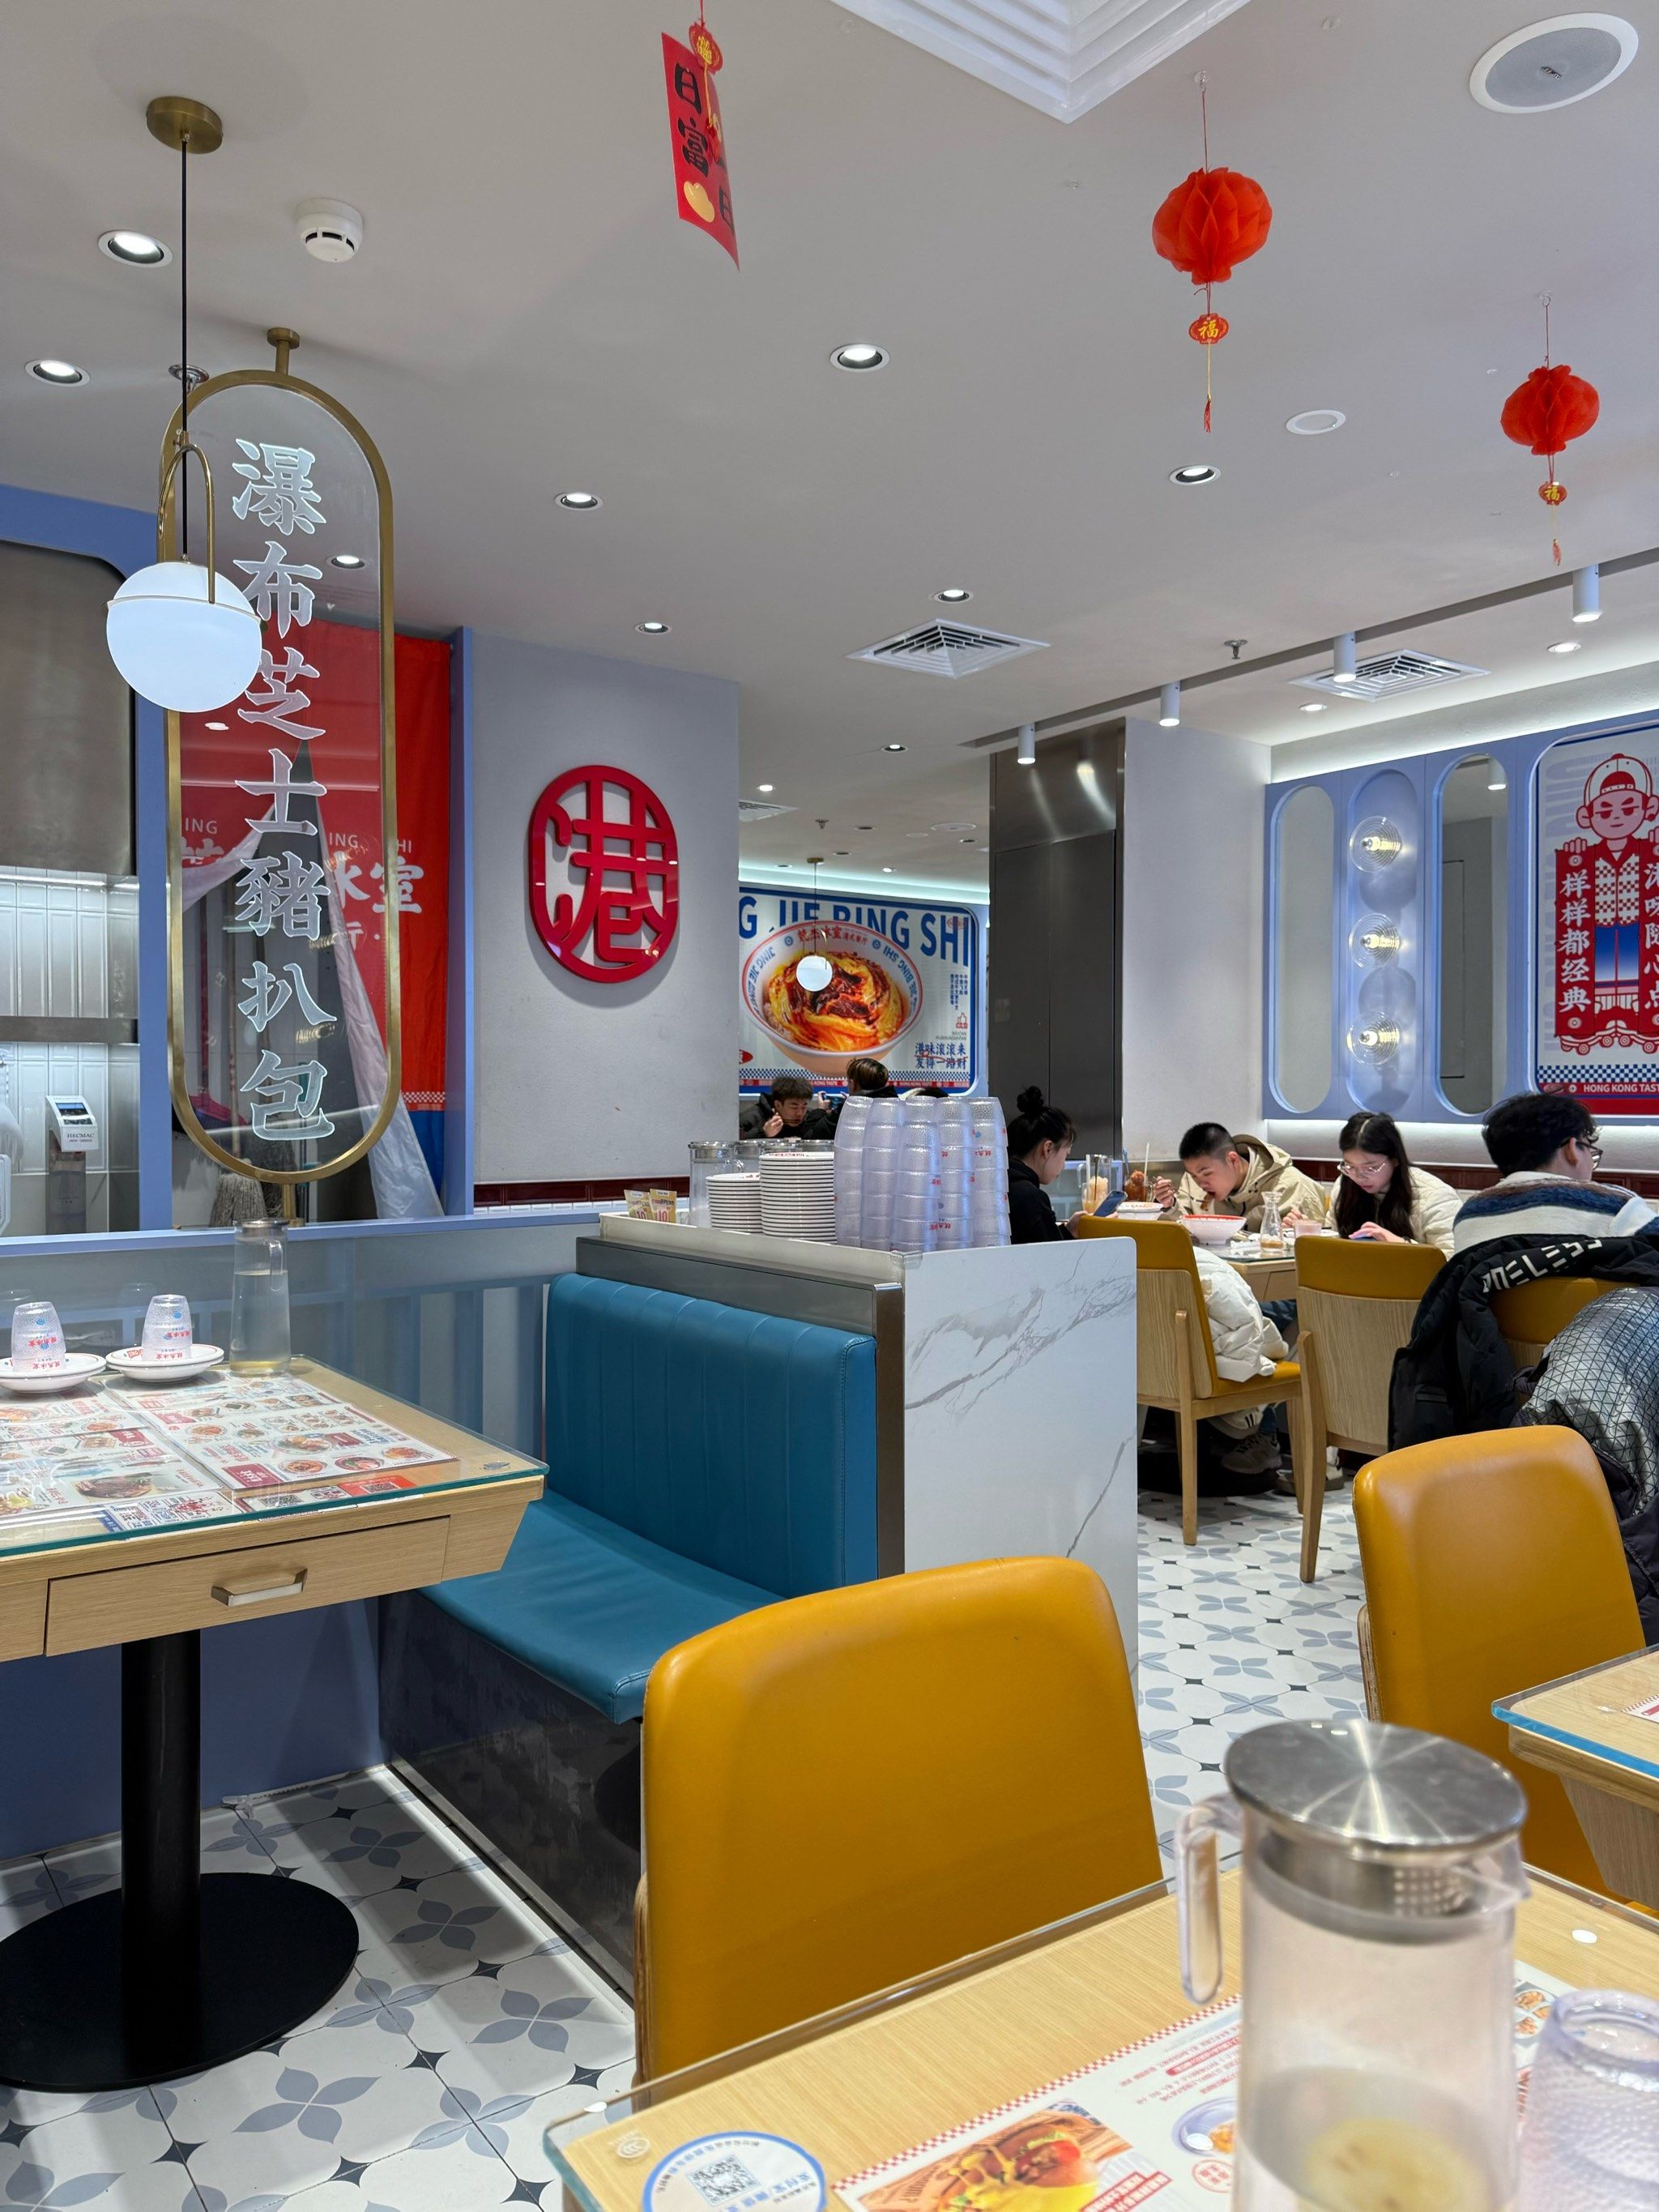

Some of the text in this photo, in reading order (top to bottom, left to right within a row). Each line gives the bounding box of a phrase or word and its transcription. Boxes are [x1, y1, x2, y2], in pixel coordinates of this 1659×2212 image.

[1198, 319, 1219, 339] 福
[232, 438, 339, 1141] 瀑布芝士豬扒包
[920, 912, 970, 967] SHI
[1556, 869, 1592, 1013] 样样都经典
[1584, 1083, 1610, 1093] HONG
[1611, 1083, 1637, 1093] KONG
